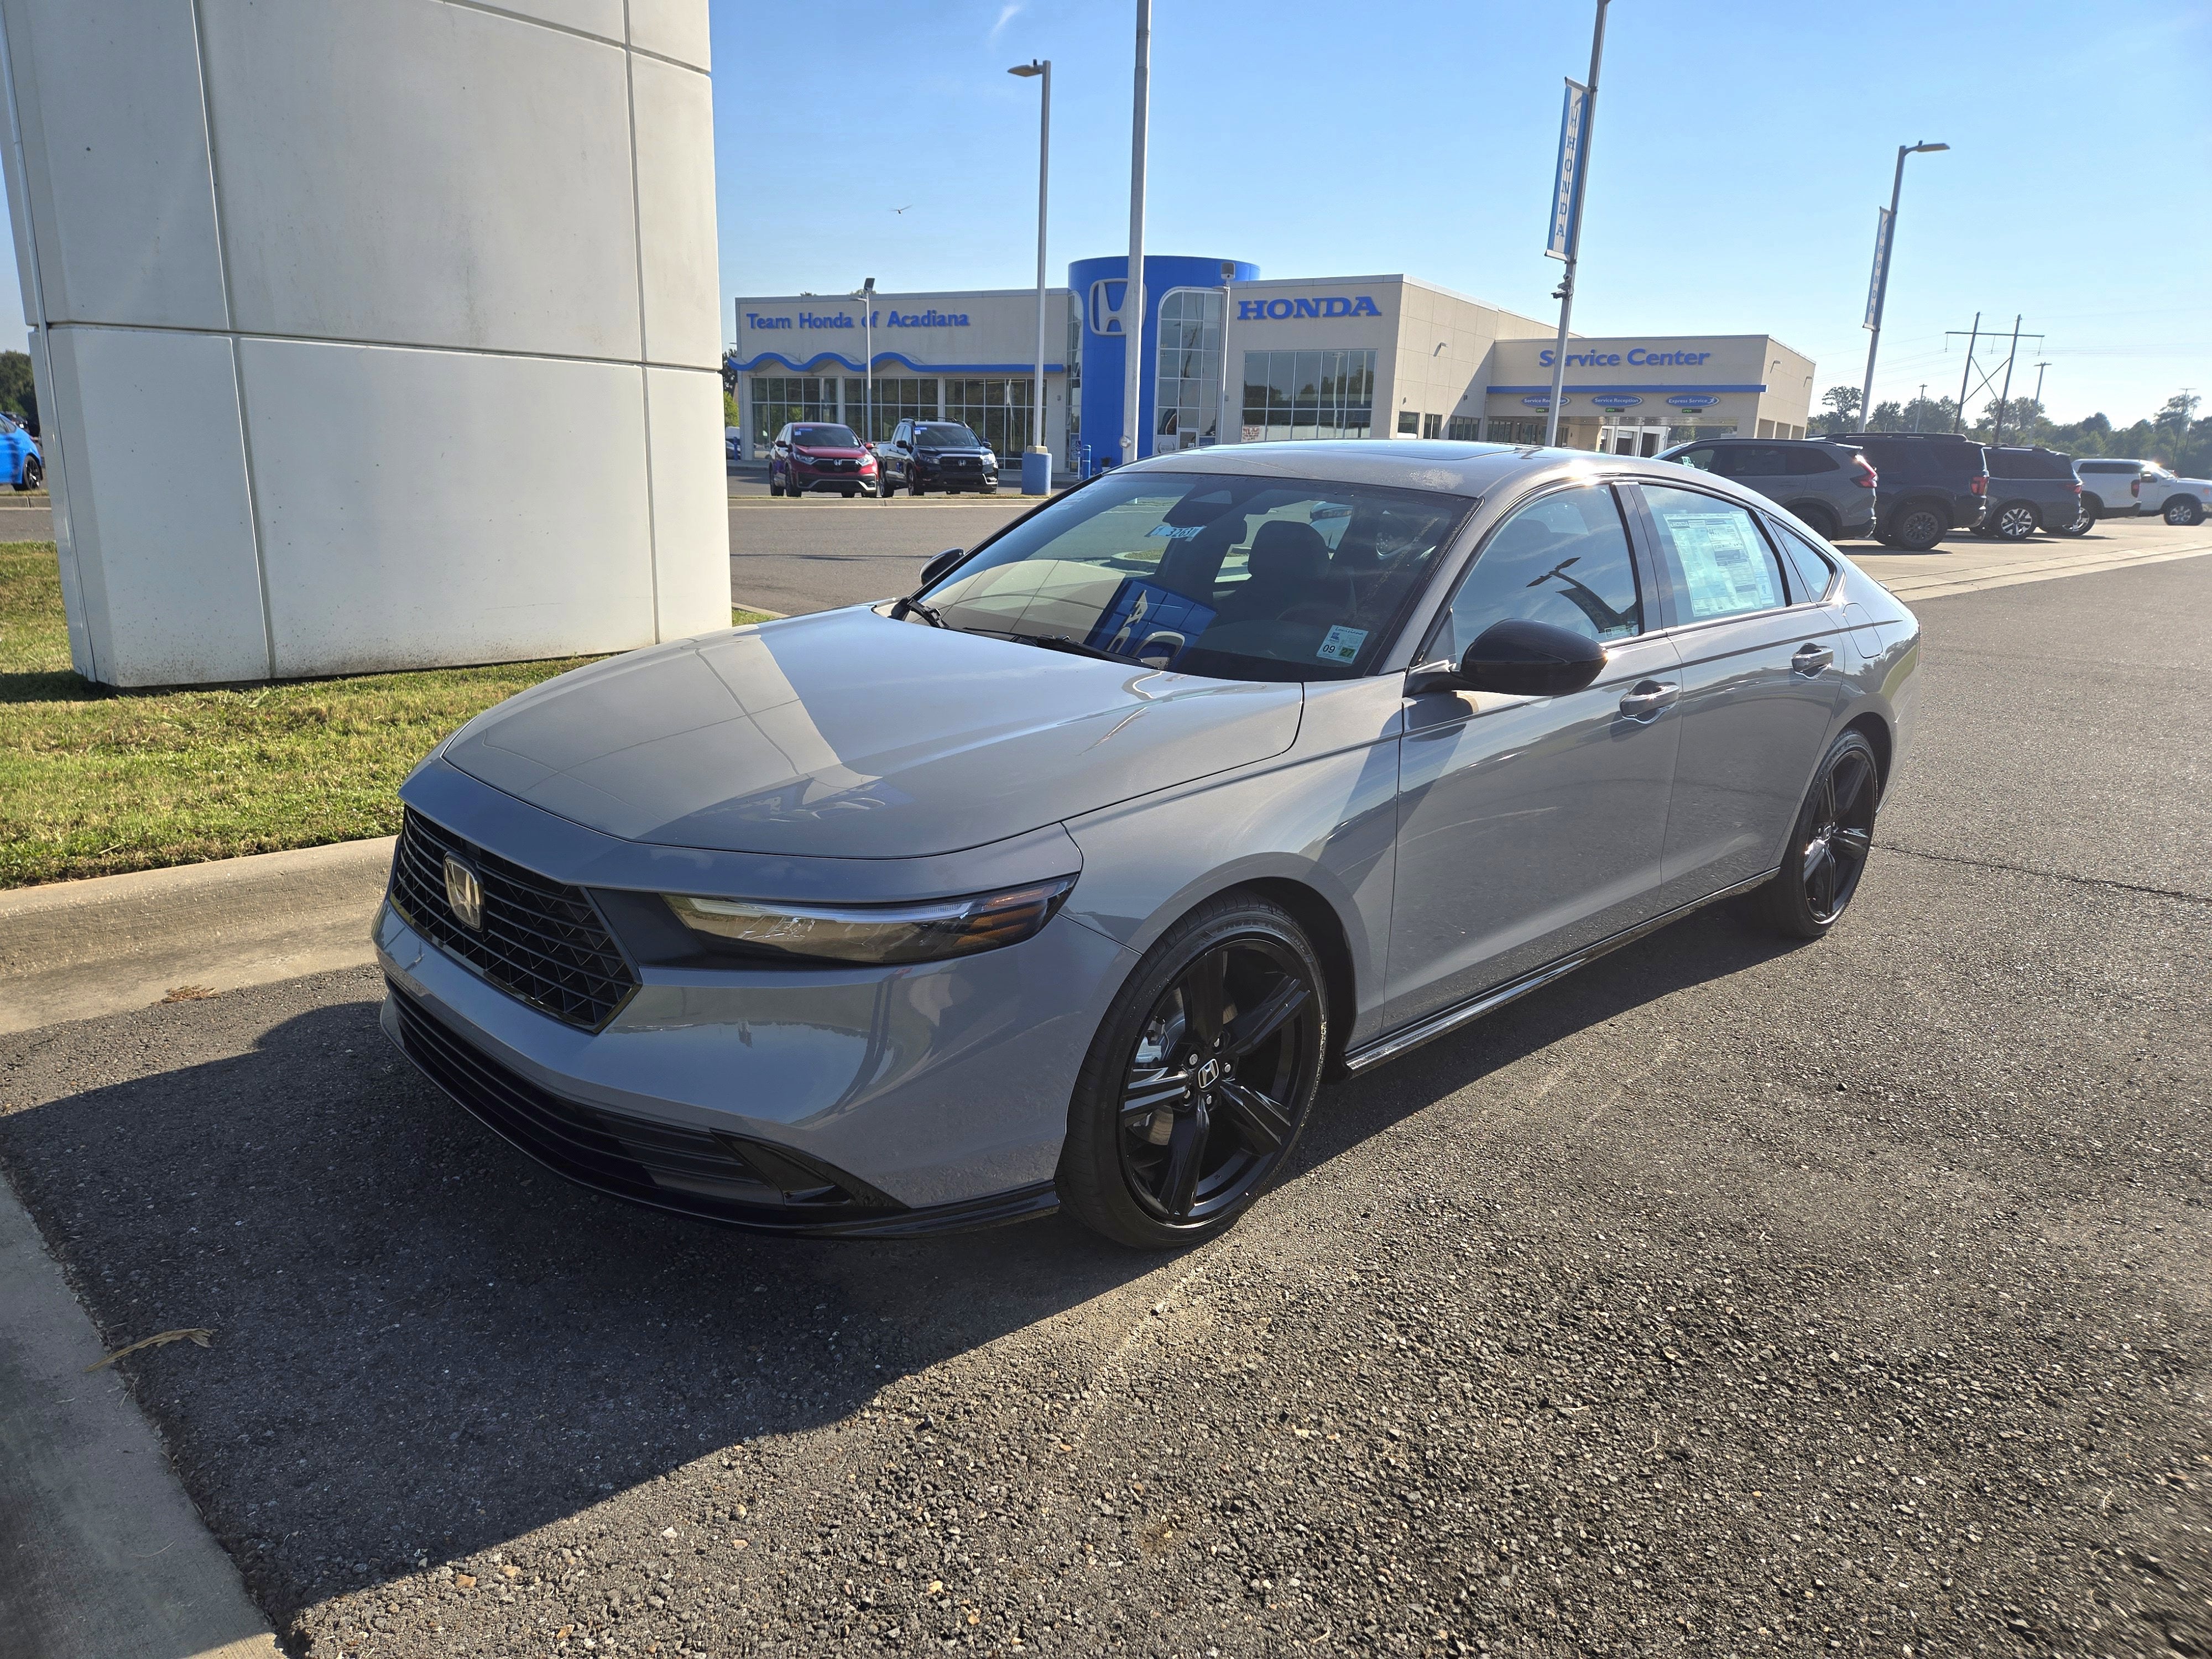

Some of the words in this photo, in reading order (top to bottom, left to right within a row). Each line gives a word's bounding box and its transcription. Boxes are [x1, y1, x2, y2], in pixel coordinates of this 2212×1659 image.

[1556, 135, 1575, 237] HONDA
[1869, 245, 1884, 314] HONDA
[1237, 296, 1382, 320] HONDA
[746, 313, 792, 329] Team
[799, 311, 854, 328] Honda
[861, 311, 880, 328] of
[887, 310, 971, 327] Acadiana
[1539, 349, 1620, 367] Srvice
[1627, 348, 1711, 366] Center
[1323, 644, 1335, 654] 09
[1340, 648, 1354, 657] 27
